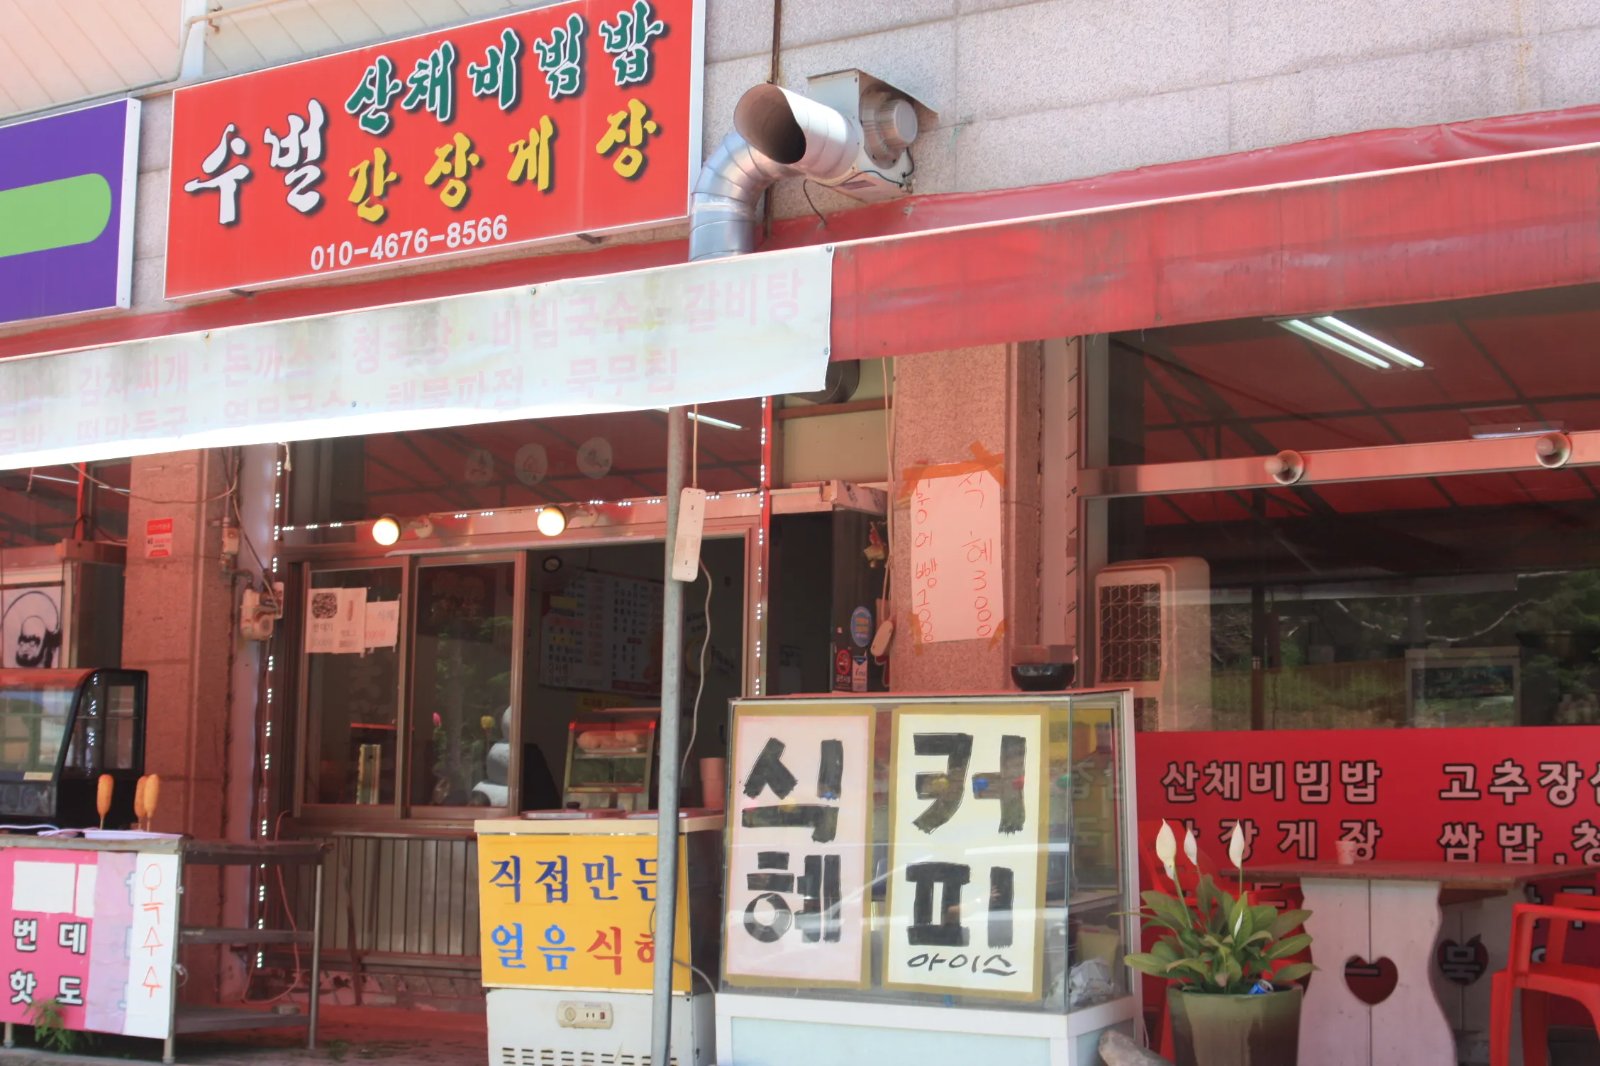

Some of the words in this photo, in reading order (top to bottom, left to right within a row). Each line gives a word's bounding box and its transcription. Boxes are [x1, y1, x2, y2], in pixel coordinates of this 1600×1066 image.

[345, 1, 665, 135] 산채비빔밥
[184, 99, 325, 225] 수벌
[348, 98, 657, 222] 간장게장
[310, 214, 508, 271] 010-4676-8566
[742, 737, 843, 943] 식혜
[906, 732, 1027, 949] 커피
[1161, 760, 1381, 803] 산채비빔밥
[1439, 759, 1600, 808] 고추장
[142, 863, 164, 998] 옥수수
[907, 952, 1017, 976] 아이스
